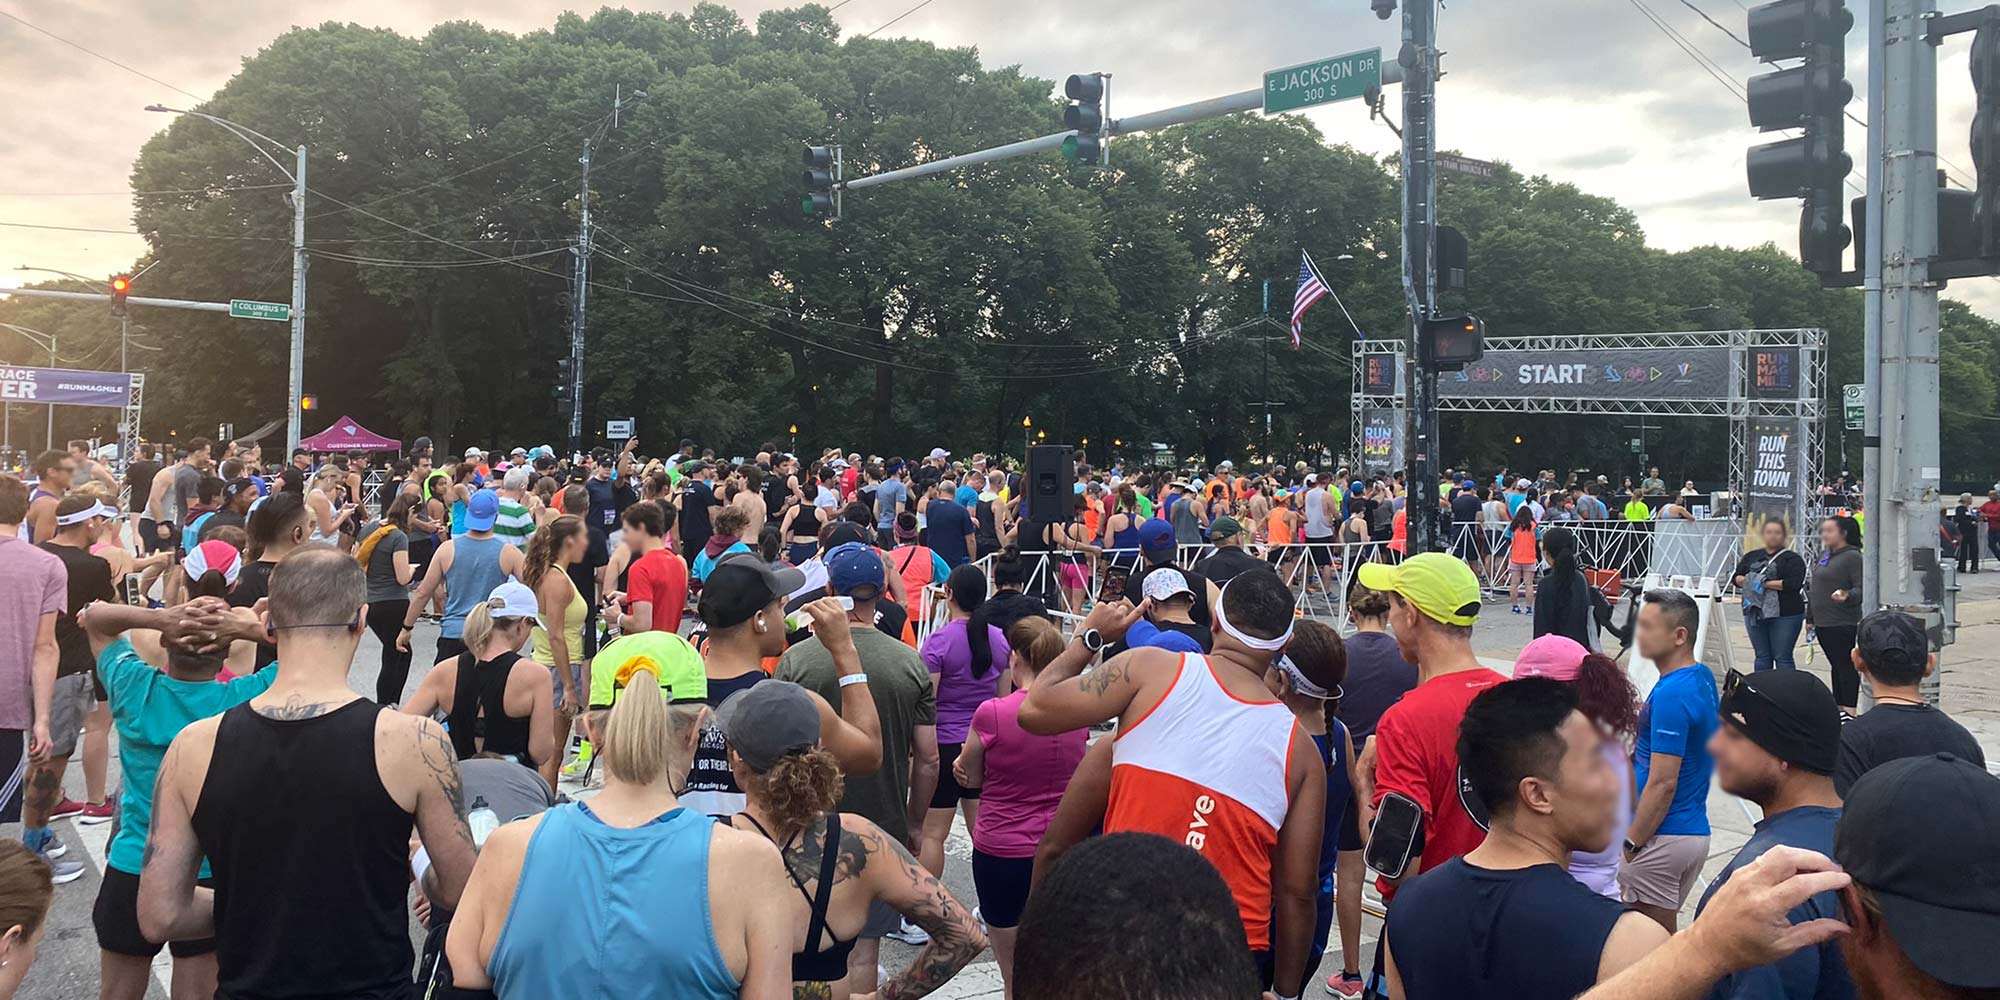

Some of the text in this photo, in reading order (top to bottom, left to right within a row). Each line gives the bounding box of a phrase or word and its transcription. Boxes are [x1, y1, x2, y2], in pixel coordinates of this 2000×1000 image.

[1269, 58, 1374, 91] E JACKSON DR
[1304, 84, 1337, 102] 300 S
[239, 302, 279, 312] COLUMBUS
[1757, 353, 1788, 364] RUN
[1518, 363, 1587, 384] START
[1757, 364, 1788, 375] MAG
[1757, 375, 1788, 386] MILE
[0, 380, 37, 399] ER
[57, 383, 123, 393] #RUNMAGMILE
[1371, 417, 1385, 425] let's
[1365, 427, 1392, 439] RUN
[1758, 435, 1788, 453] RUN
[1365, 446, 1390, 455] PLAY
[1365, 459, 1390, 467] together
[1758, 452, 1787, 470] THIS
[1752, 469, 1791, 488] TOWN
